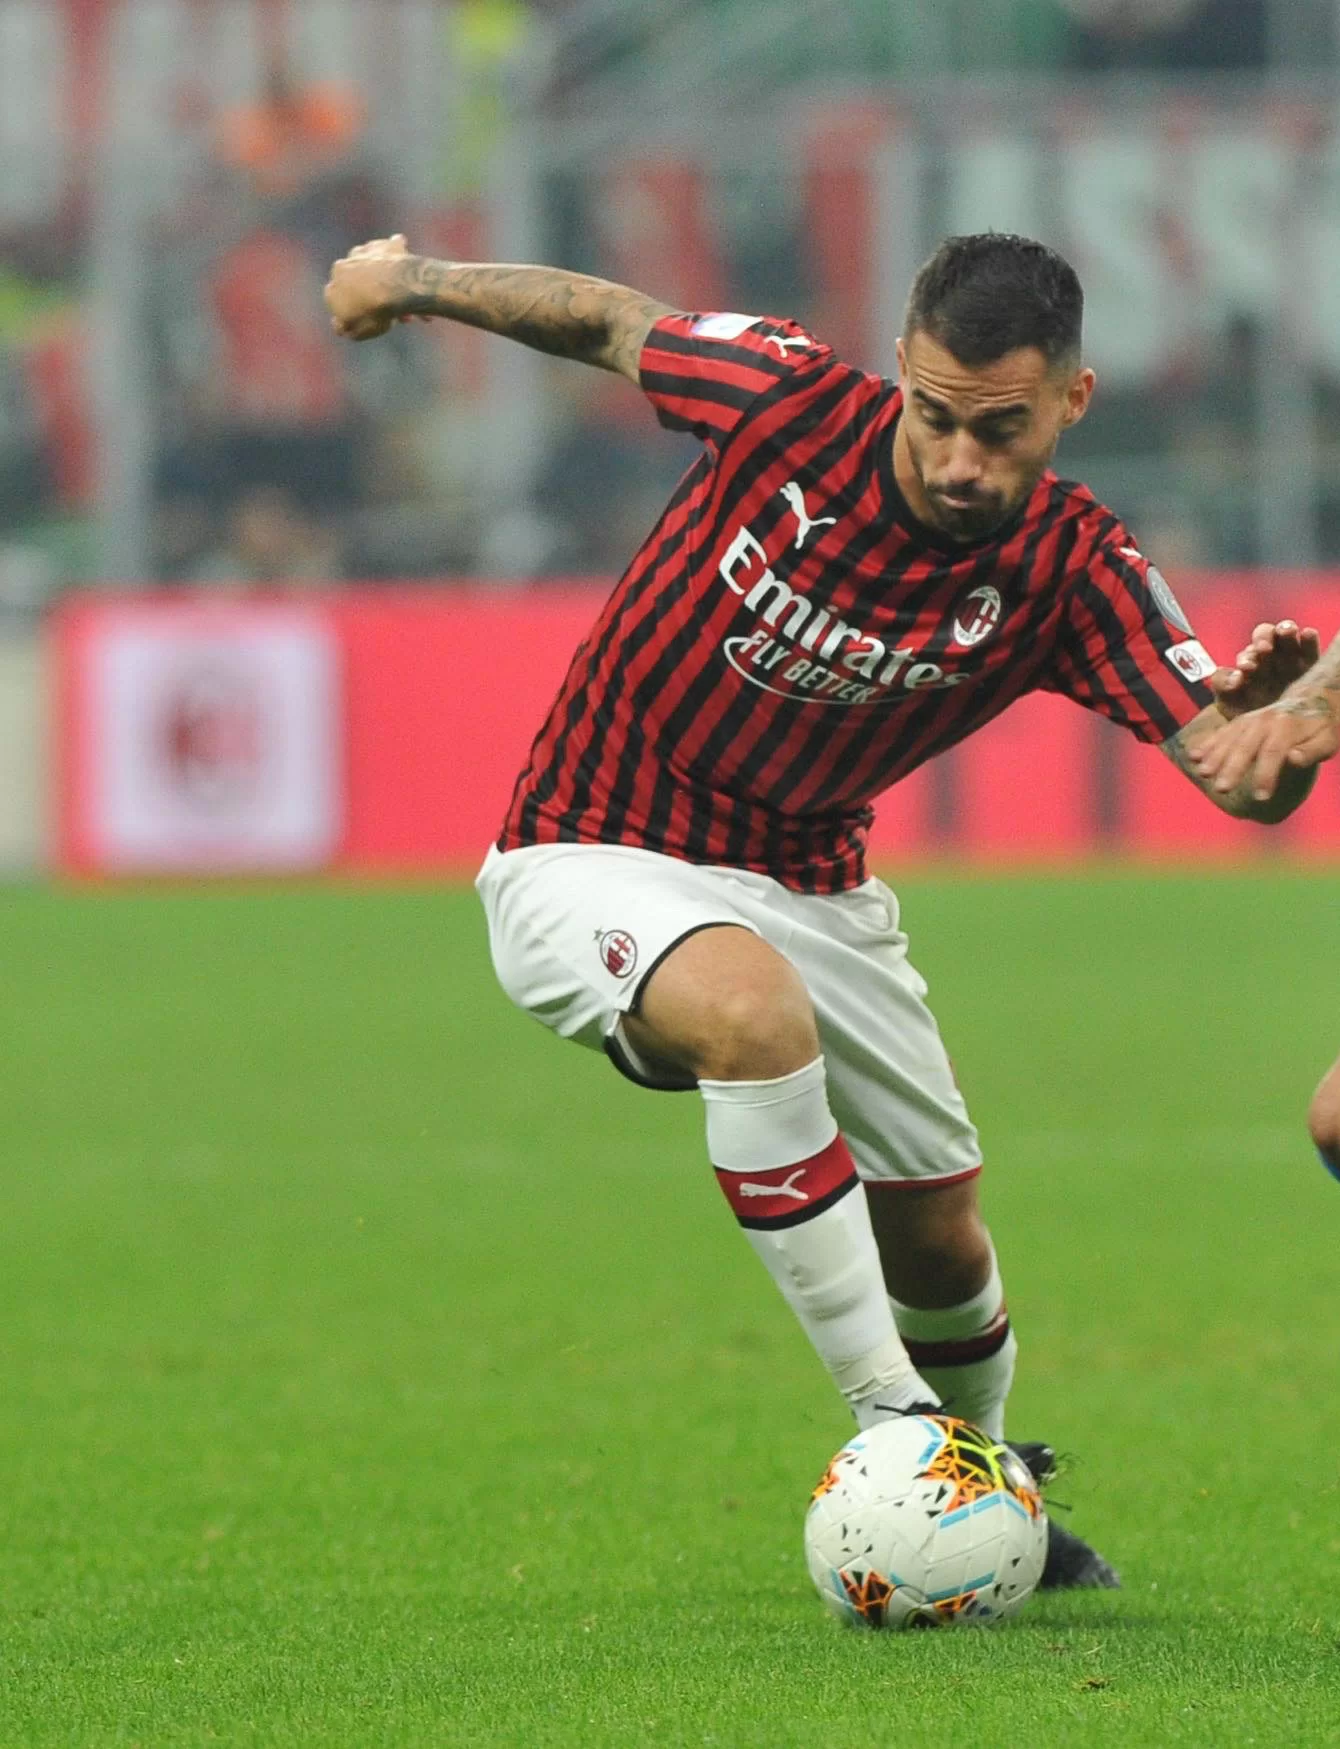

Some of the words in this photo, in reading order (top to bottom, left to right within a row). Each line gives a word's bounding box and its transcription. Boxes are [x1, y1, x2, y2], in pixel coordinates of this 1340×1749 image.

[719, 525, 970, 690] Emirates
[739, 628, 792, 671] FLY
[782, 657, 880, 703] BETTER
